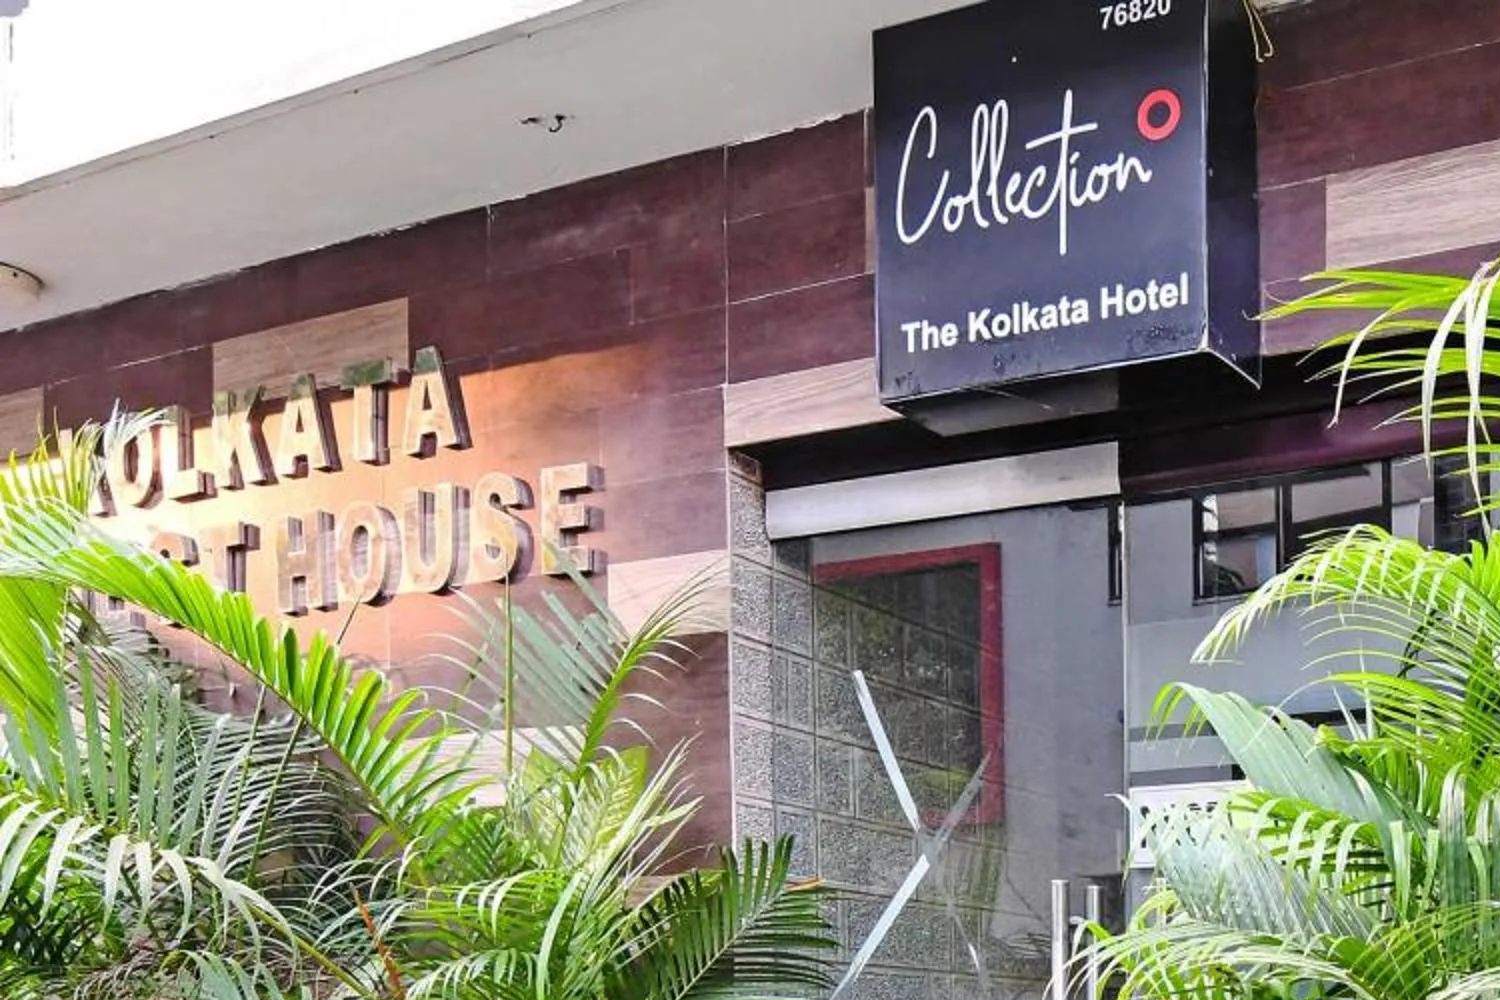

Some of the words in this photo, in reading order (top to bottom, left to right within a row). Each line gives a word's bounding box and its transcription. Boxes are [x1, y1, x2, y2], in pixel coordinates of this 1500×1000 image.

[1099, 0, 1172, 30] 76820
[895, 88, 1153, 255] Collection
[901, 319, 958, 353] The
[968, 297, 1089, 343] Kolkata
[1100, 272, 1189, 320] Hotel
[273, 462, 607, 616] HOUSE
